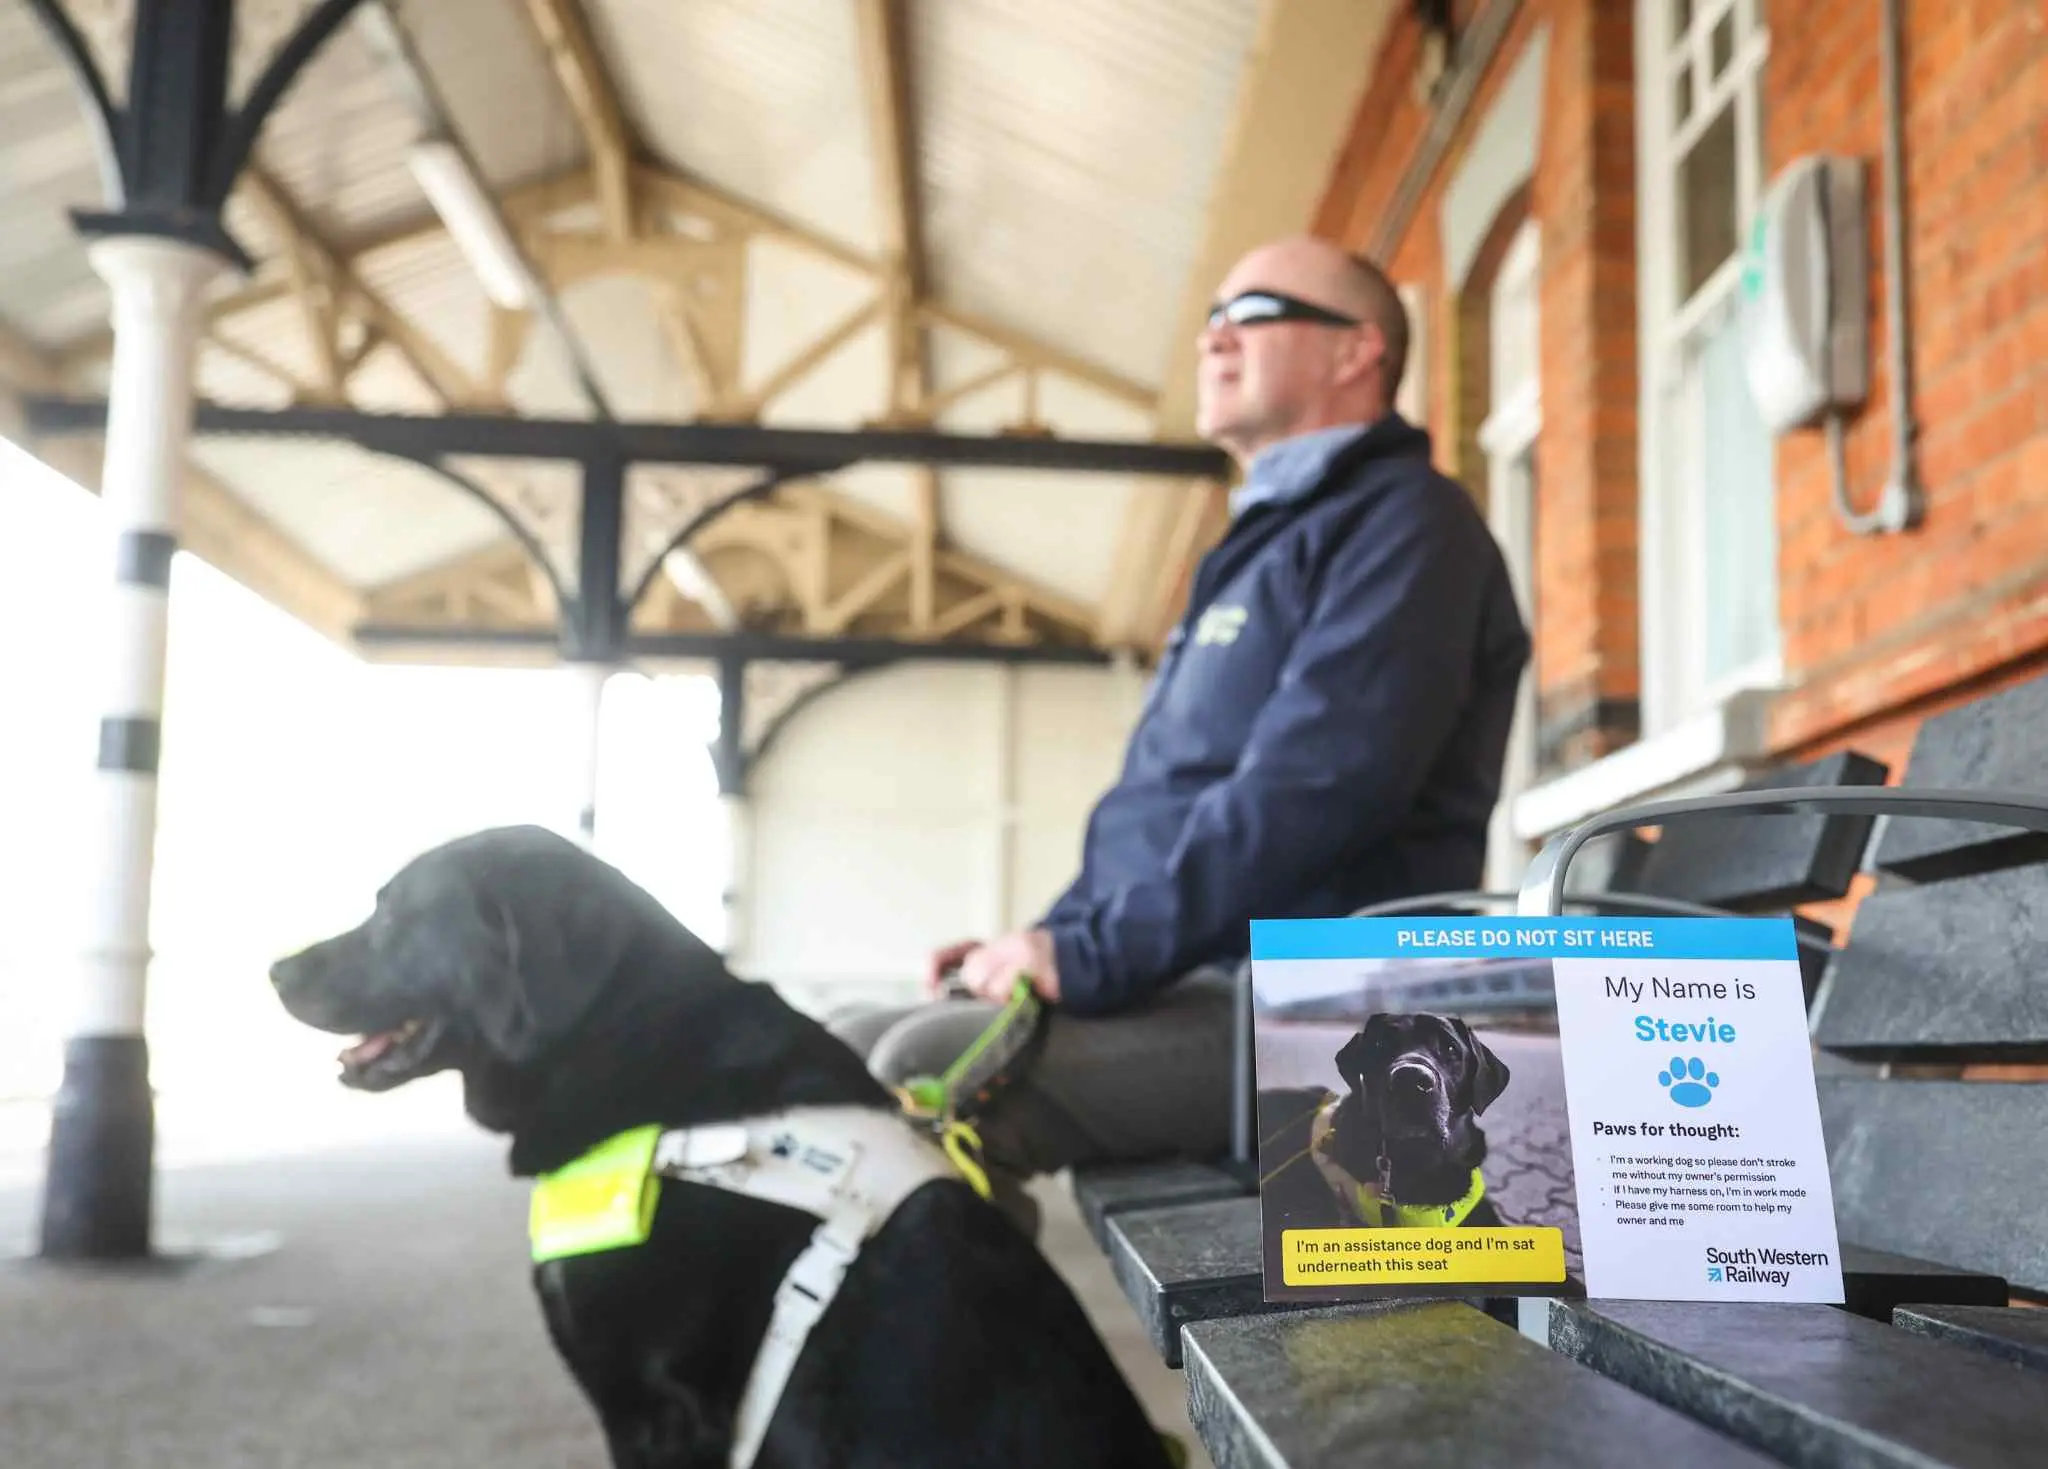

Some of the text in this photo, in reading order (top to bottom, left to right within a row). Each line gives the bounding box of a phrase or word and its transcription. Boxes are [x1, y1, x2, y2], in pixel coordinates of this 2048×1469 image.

[1398, 930, 1653, 947] PLEASE DO NOT SIT HERE
[1606, 977, 1755, 1003] My Name is
[1635, 1016, 1735, 1043] Stevie
[1594, 1122, 1739, 1141] Paws for thought:
[1610, 1156, 1626, 1165] I'm
[1635, 1156, 1673, 1167] working
[1675, 1156, 1693, 1168] dog
[1708, 1157, 1738, 1168] please
[1740, 1157, 1764, 1167] don't
[1766, 1158, 1795, 1167] stroke
[1630, 1171, 1665, 1180] without
[1668, 1173, 1683, 1182] my
[1685, 1172, 1722, 1181] owner's
[1724, 1173, 1776, 1183] permission
[1614, 1185, 1621, 1194] If
[1628, 1185, 1650, 1195] have
[1653, 1187, 1667, 1197] my
[1670, 1187, 1708, 1196] harness
[1710, 1189, 1725, 1198] on,
[1726, 1187, 1741, 1196] I'm
[1743, 1187, 1752, 1196] in
[1754, 1188, 1777, 1197] work
[1780, 1188, 1806, 1197] mode
[1616, 1200, 1647, 1210] Please
[1649, 1201, 1669, 1212] give
[1671, 1202, 1686, 1210] me
[1688, 1203, 1714, 1211] some
[1743, 1203, 1753, 1212] to
[1755, 1203, 1775, 1214] help
[1777, 1205, 1792, 1214] my
[1617, 1216, 1684, 1226] owner and me
[1297, 1238, 1535, 1253] I'm an assistance dog and I'm sat
[1706, 1248, 1828, 1265] South Western
[1298, 1258, 1448, 1272] underneath this seat
[1726, 1267, 1790, 1287] Railway
